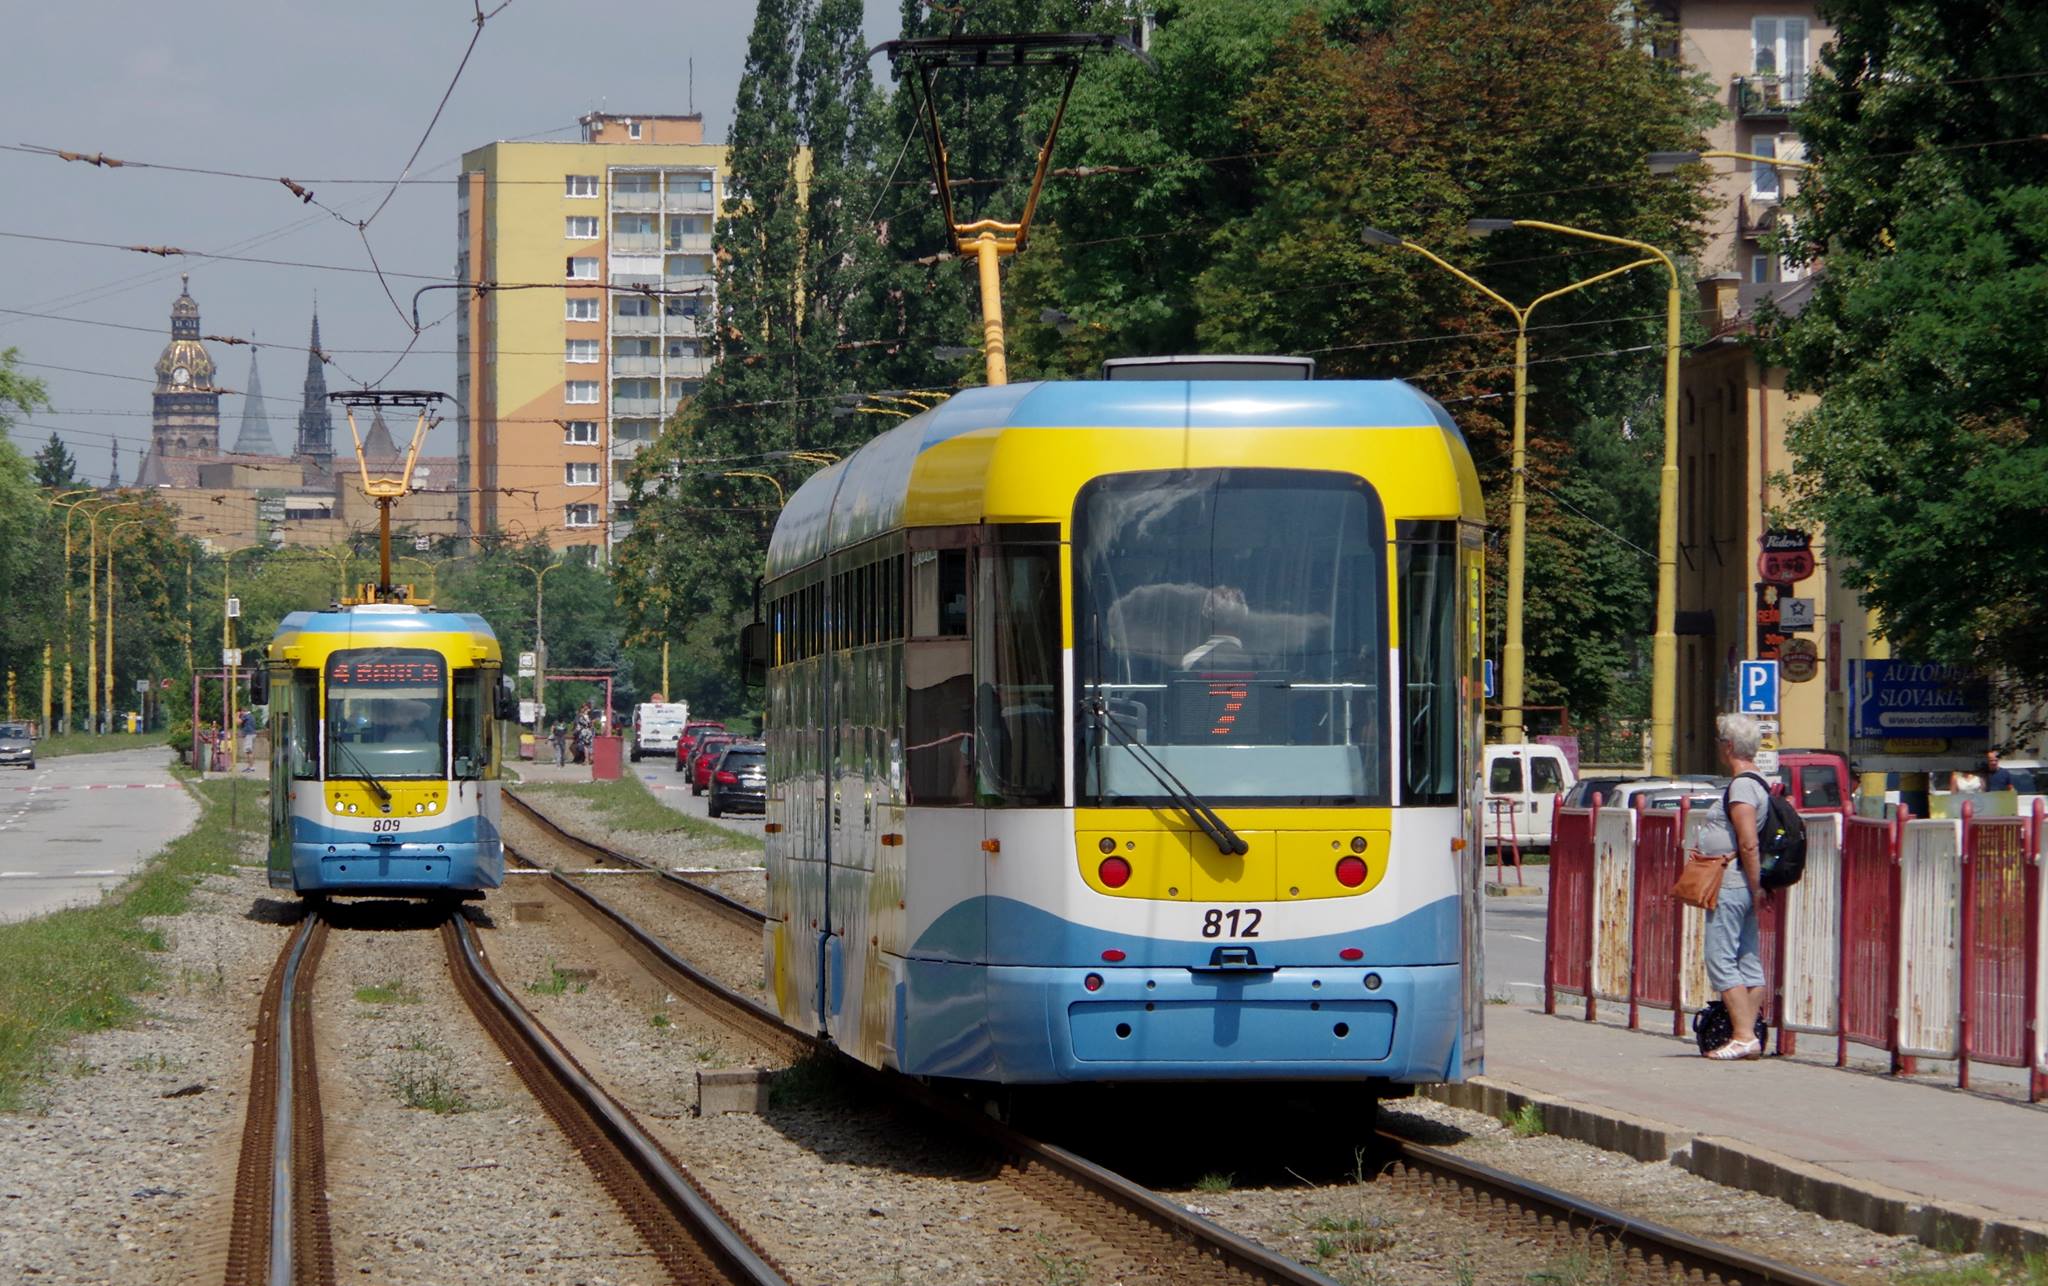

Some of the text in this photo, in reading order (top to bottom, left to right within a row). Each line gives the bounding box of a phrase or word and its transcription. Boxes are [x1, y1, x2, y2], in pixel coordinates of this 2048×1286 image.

[333, 664, 350, 682] 4
[1749, 667, 1767, 696] P
[1209, 683, 1248, 734] 7
[1879, 688, 1965, 707] SLOVAKIA
[372, 819, 400, 832] 809
[1202, 908, 1263, 938] 812
